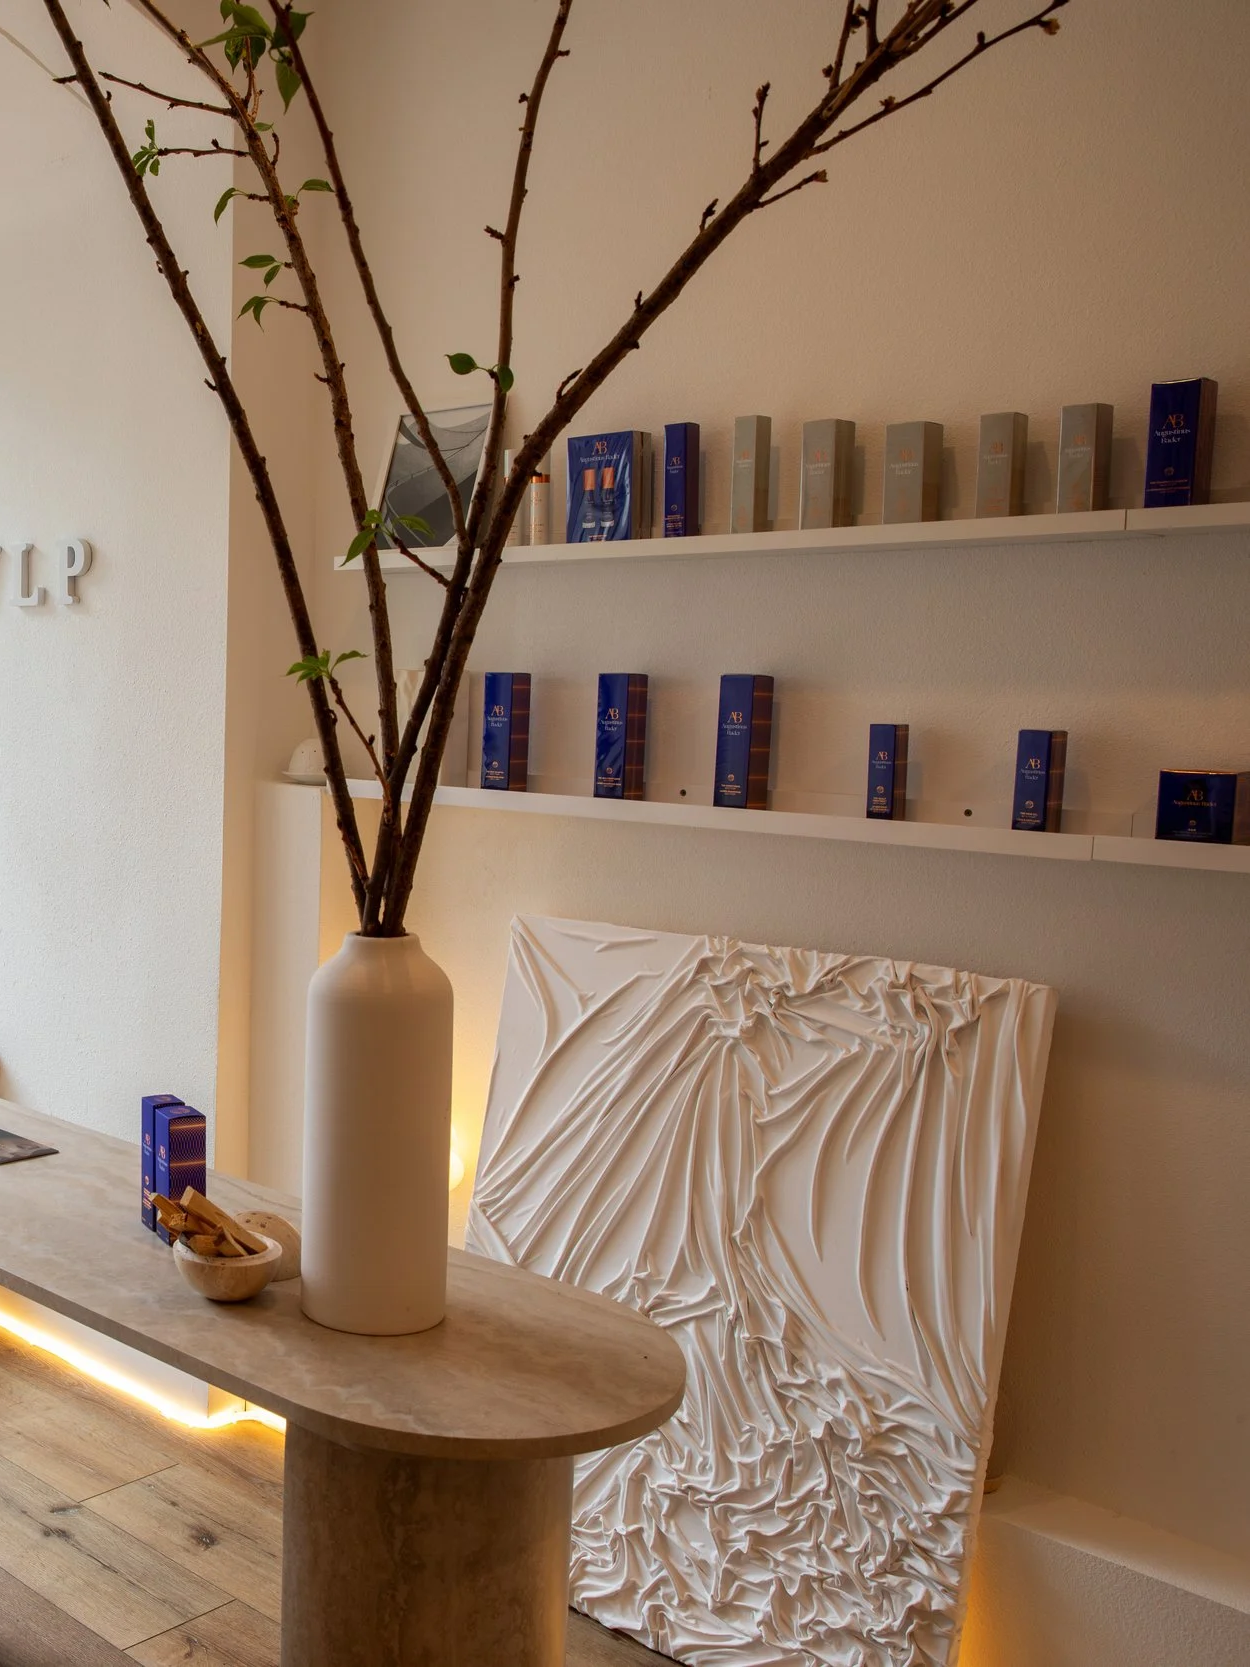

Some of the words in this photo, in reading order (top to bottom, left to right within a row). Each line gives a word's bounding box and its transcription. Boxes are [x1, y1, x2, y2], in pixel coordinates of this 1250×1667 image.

[605, 708, 619, 720] AB
[727, 711, 743, 723] AB
[1025, 758, 1041, 770] AB
